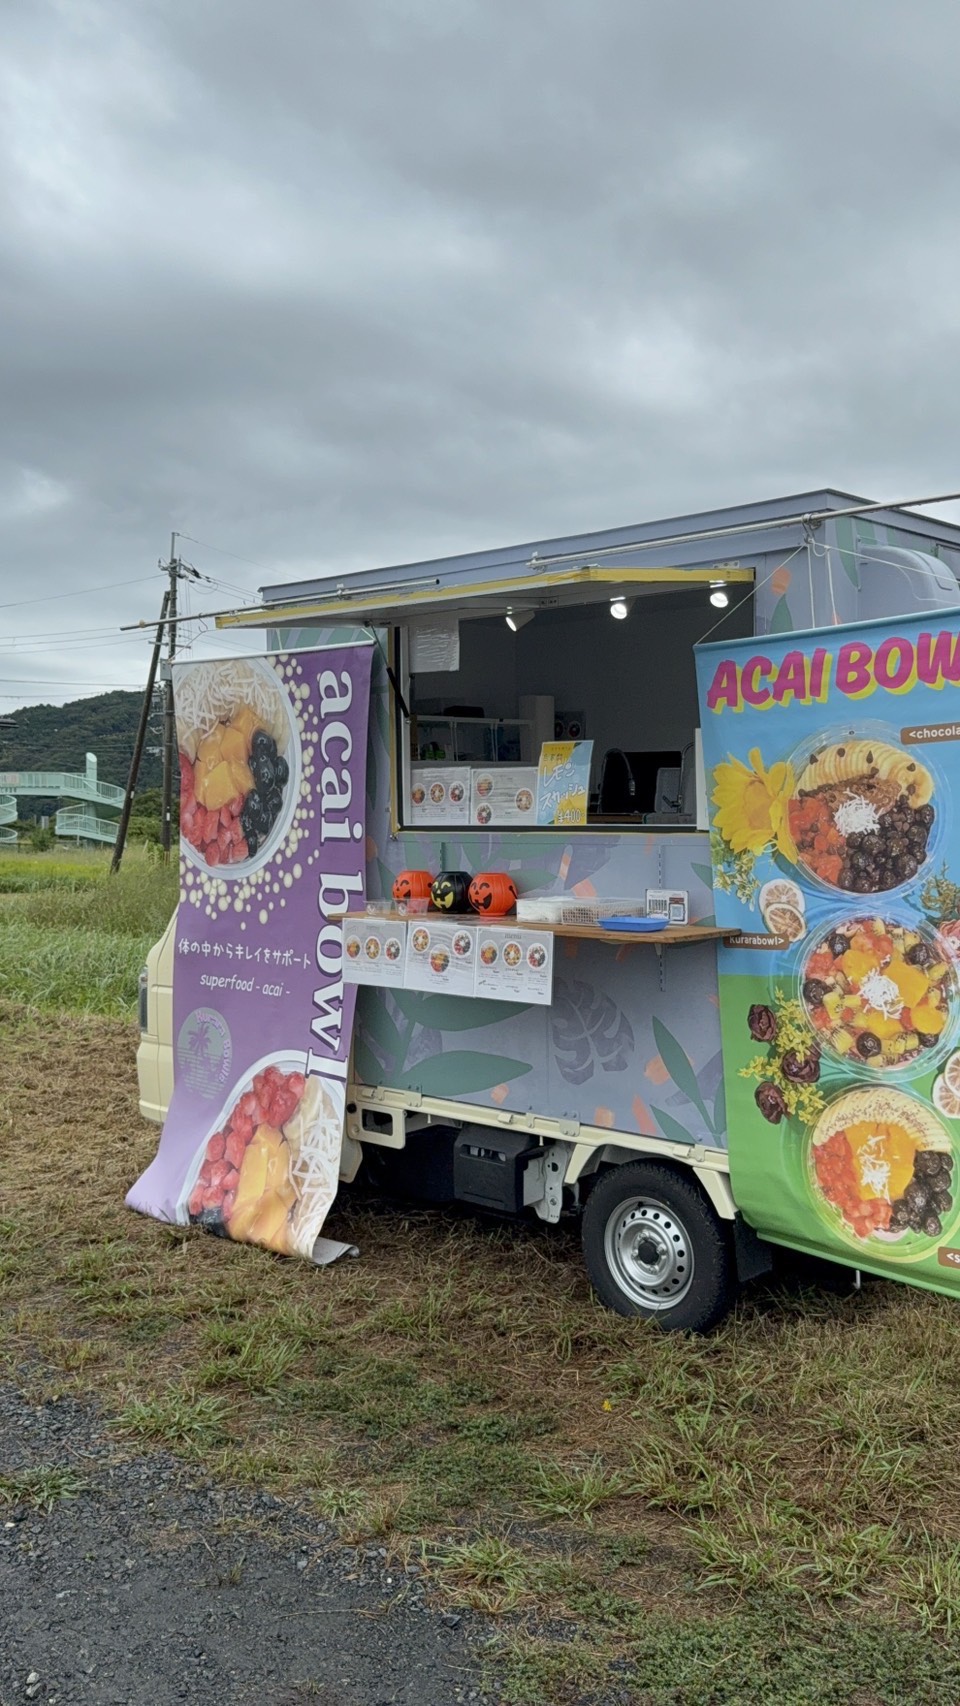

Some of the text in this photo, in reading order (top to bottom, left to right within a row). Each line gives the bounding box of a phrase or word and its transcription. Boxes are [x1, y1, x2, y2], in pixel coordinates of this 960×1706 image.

[706, 648, 832, 715] ACAI
[306, 670, 364, 1082] acai bowl
[178, 938, 311, 970] 体の中からキレイをサポート
[200, 974, 255, 992] superfood
